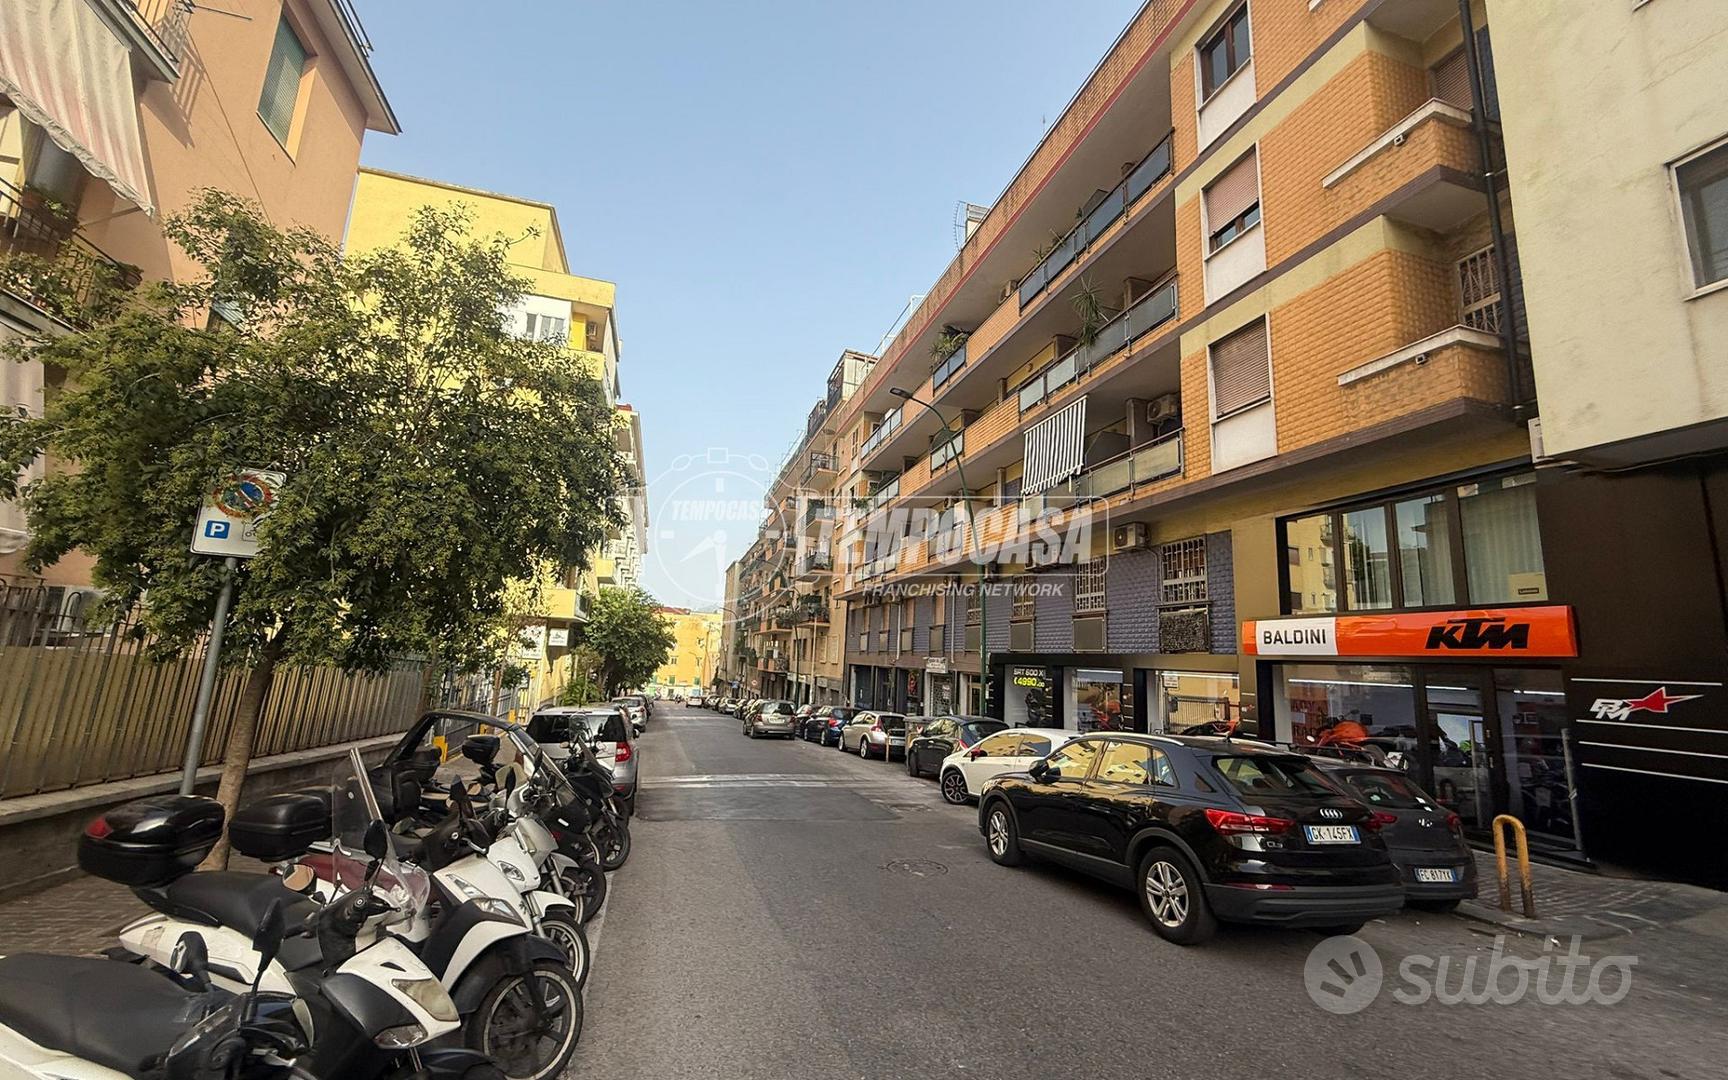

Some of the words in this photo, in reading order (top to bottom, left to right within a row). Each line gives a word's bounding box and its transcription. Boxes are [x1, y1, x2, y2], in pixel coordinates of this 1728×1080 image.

[209, 522, 226, 537] P
[1263, 628, 1327, 645] BALDINI
[1425, 617, 1530, 650] KTM
